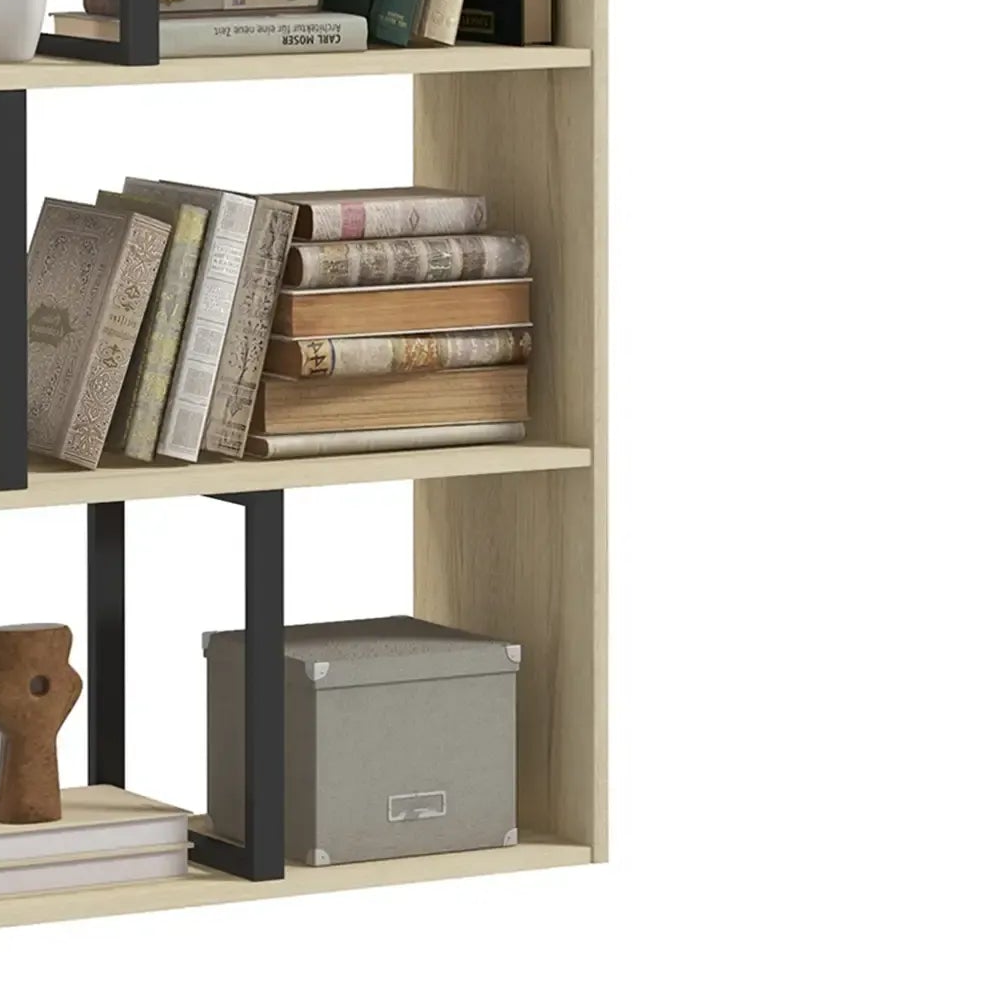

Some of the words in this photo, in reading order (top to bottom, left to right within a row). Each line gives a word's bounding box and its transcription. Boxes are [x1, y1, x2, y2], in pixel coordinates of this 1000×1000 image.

[213, 26, 231, 38] Zeit
[233, 25, 255, 35] neue
[256, 24, 276, 34] eine
[278, 23, 292, 34] für
[292, 23, 342, 34] Architektur
[281, 35, 315, 46] MOSER
[318, 34, 342, 45] CARL
